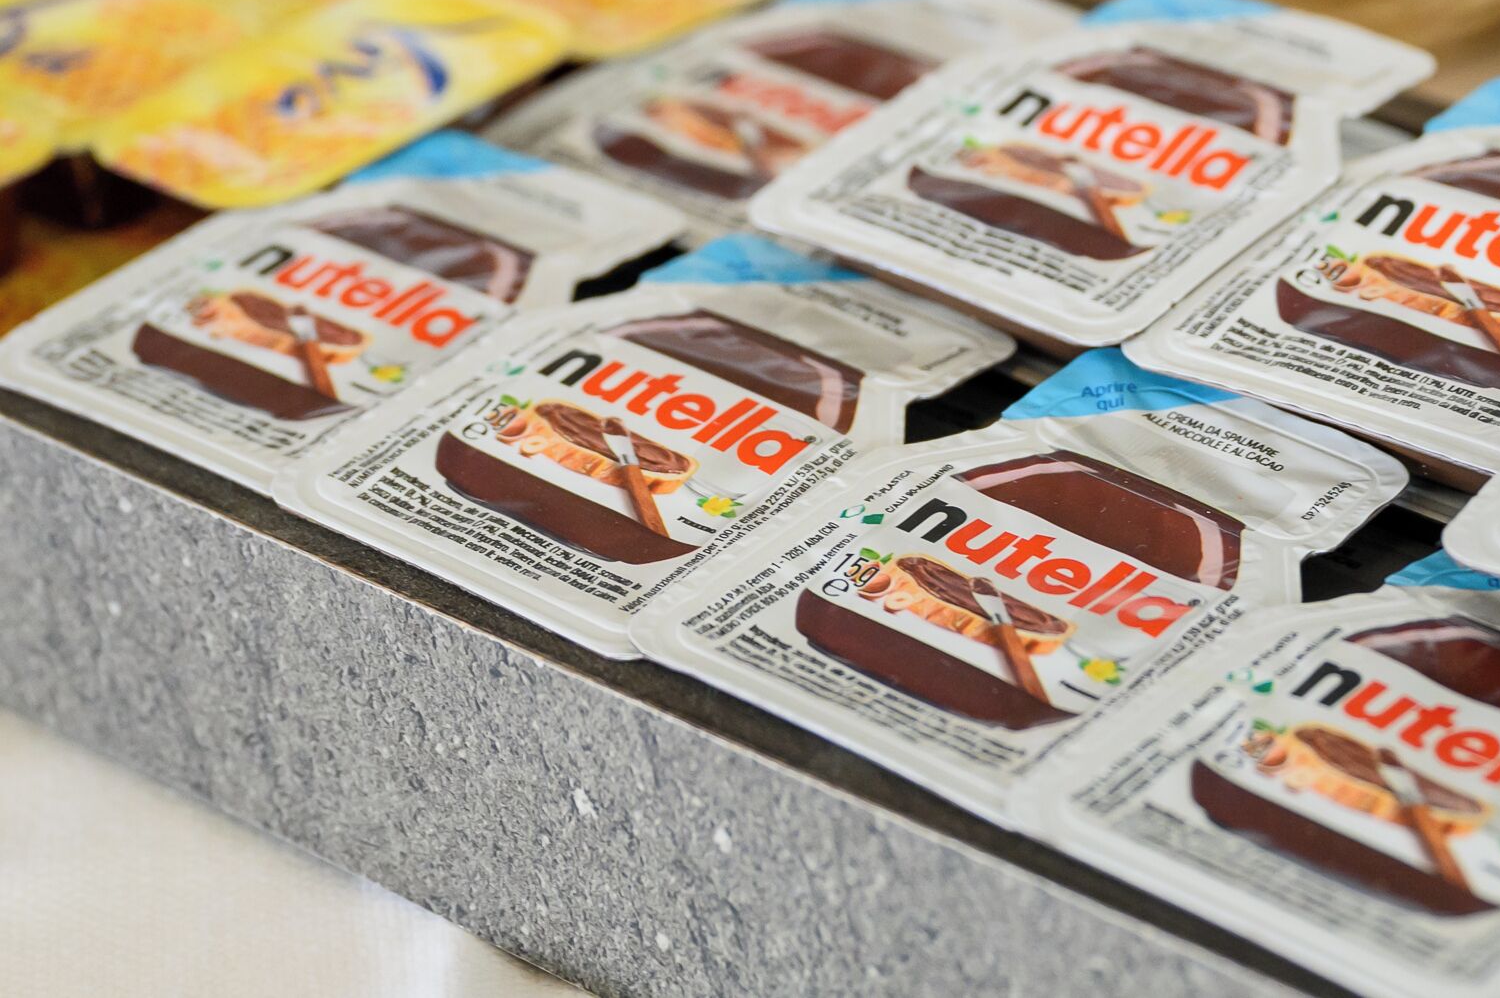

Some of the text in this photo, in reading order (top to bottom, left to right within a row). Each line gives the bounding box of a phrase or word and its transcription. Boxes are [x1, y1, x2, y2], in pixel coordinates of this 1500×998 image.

[1000, 87, 1254, 190] nutella
[239, 245, 479, 348] nutella
[1080, 381, 1137, 401] Aprire
[1371, 360, 1423, 380] NOCCIOLE
[1445, 385, 1477, 398] LATTE
[474, 398, 517, 432] 15g
[538, 349, 814, 477] nutella
[1096, 397, 1125, 412] qui
[1142, 411, 1284, 473] ALLE NOCCIOLE E AL CACAO
[1166, 409, 1281, 459] CREMA DA SPALMARE
[804, 469, 829, 484] 57,5
[1300, 481, 1353, 522] CP75245245
[507, 525, 555, 549] NOCCIOLE
[572, 557, 601, 572] LATTE
[640, 565, 687, 598] nutrizionali
[682, 551, 707, 567] medi
[700, 542, 720, 554] per
[711, 528, 735, 543] 100
[737, 503, 771, 525] energia
[761, 486, 791, 505] 2252
[793, 463, 816, 477] 539
[491, 554, 524, 570] vedere
[506, 548, 538, 565] Tenere
[743, 565, 777, 587] Ferrero
[779, 544, 809, 562] 12051
[799, 532, 825, 548] Alba
[834, 553, 880, 589] 15g
[898, 496, 1195, 639] nutella
[752, 581, 777, 596] Alba
[770, 587, 790, 597] 90
[781, 580, 801, 590] 96
[791, 571, 812, 583] 90
